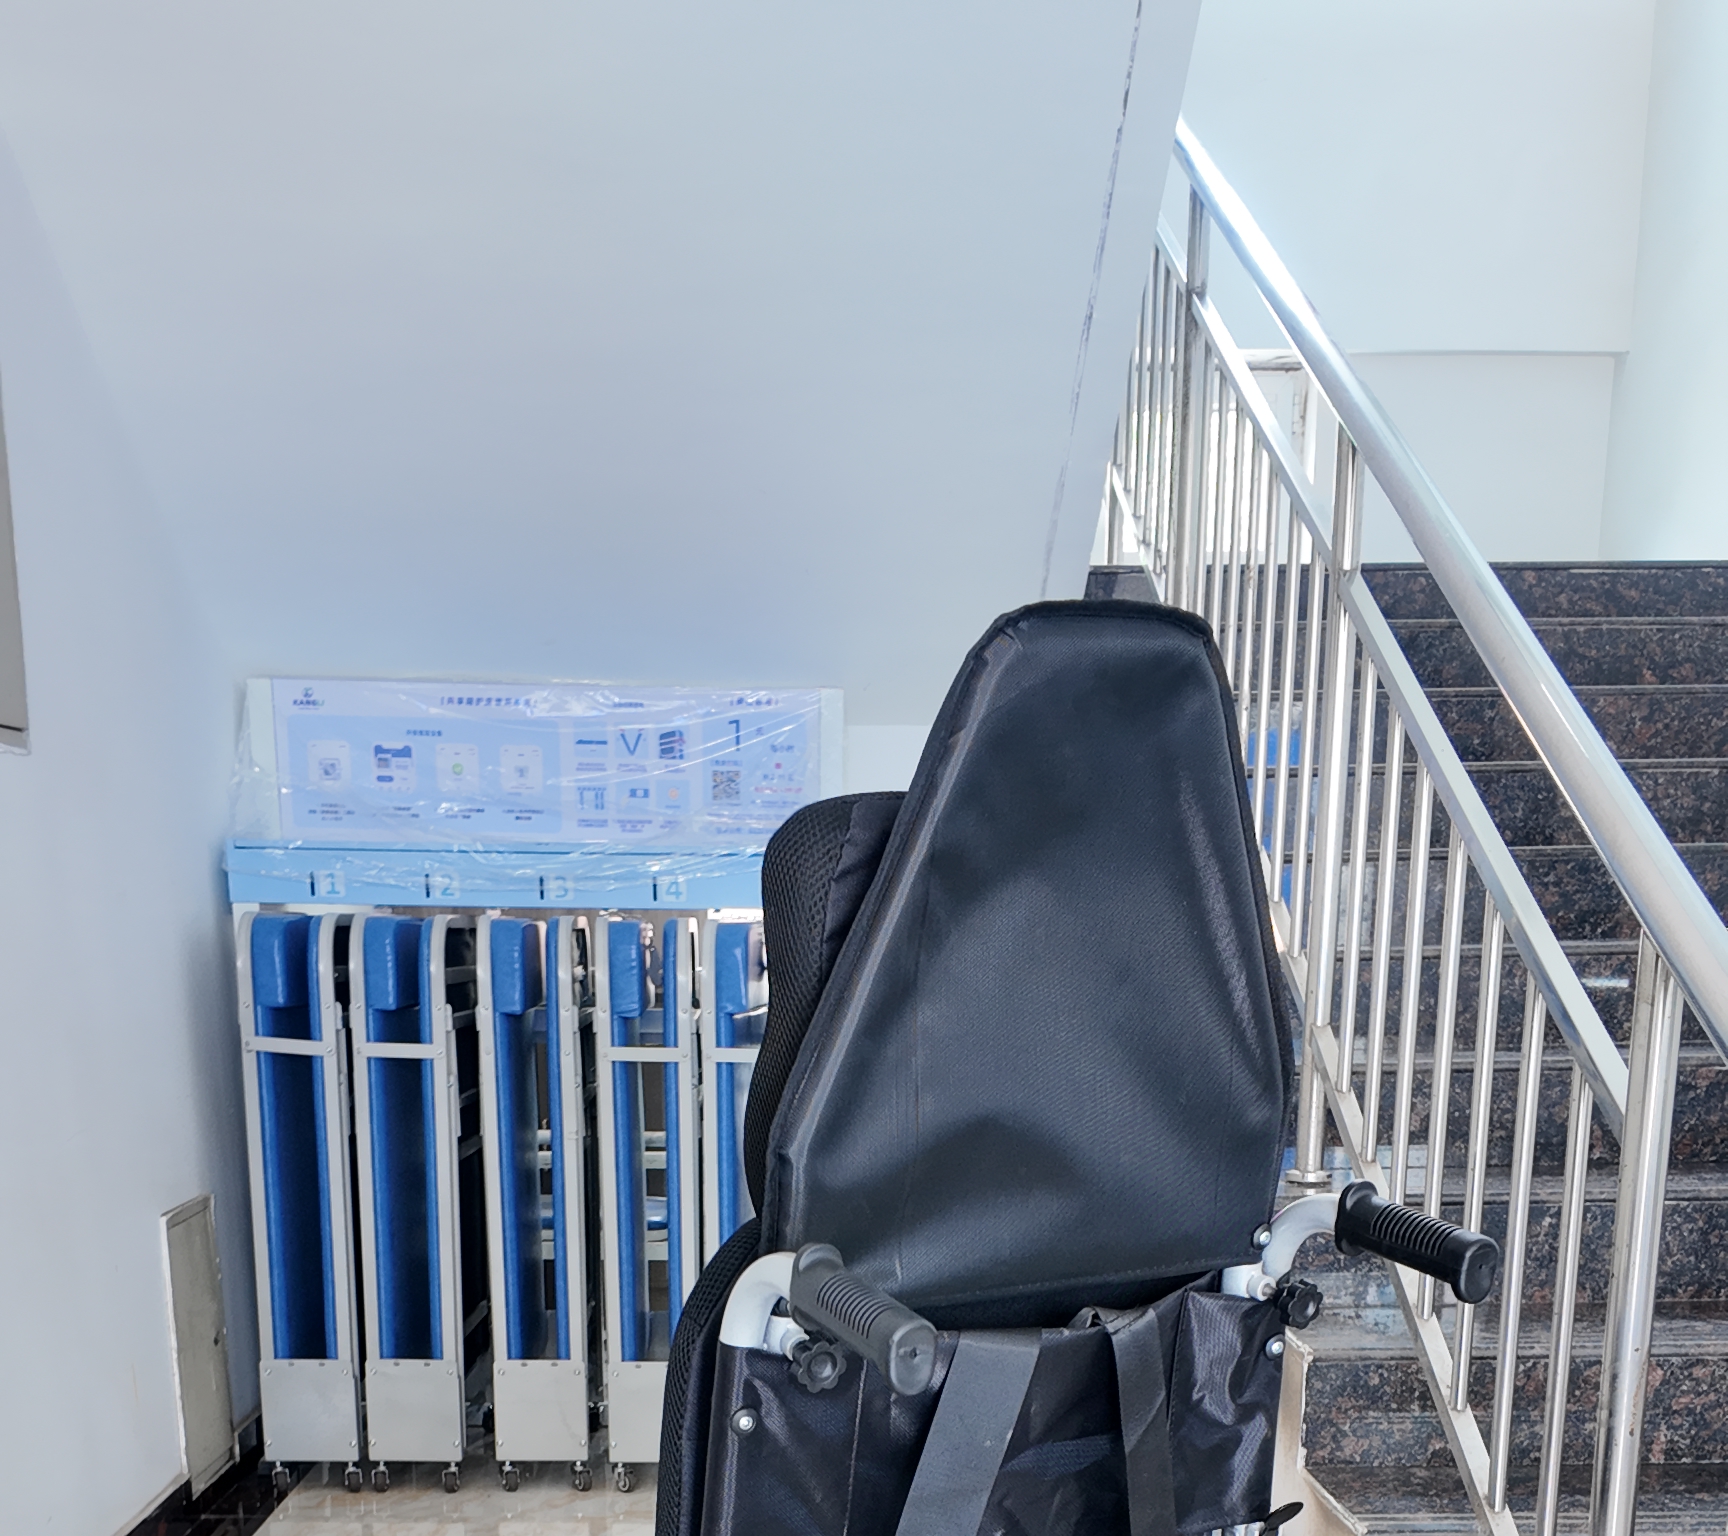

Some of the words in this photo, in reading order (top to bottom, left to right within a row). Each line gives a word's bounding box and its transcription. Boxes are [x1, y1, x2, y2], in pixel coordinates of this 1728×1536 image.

[325, 871, 341, 896] 1
[440, 873, 455, 897] 2
[553, 877, 569, 899] 3
[664, 880, 683, 900] 4
